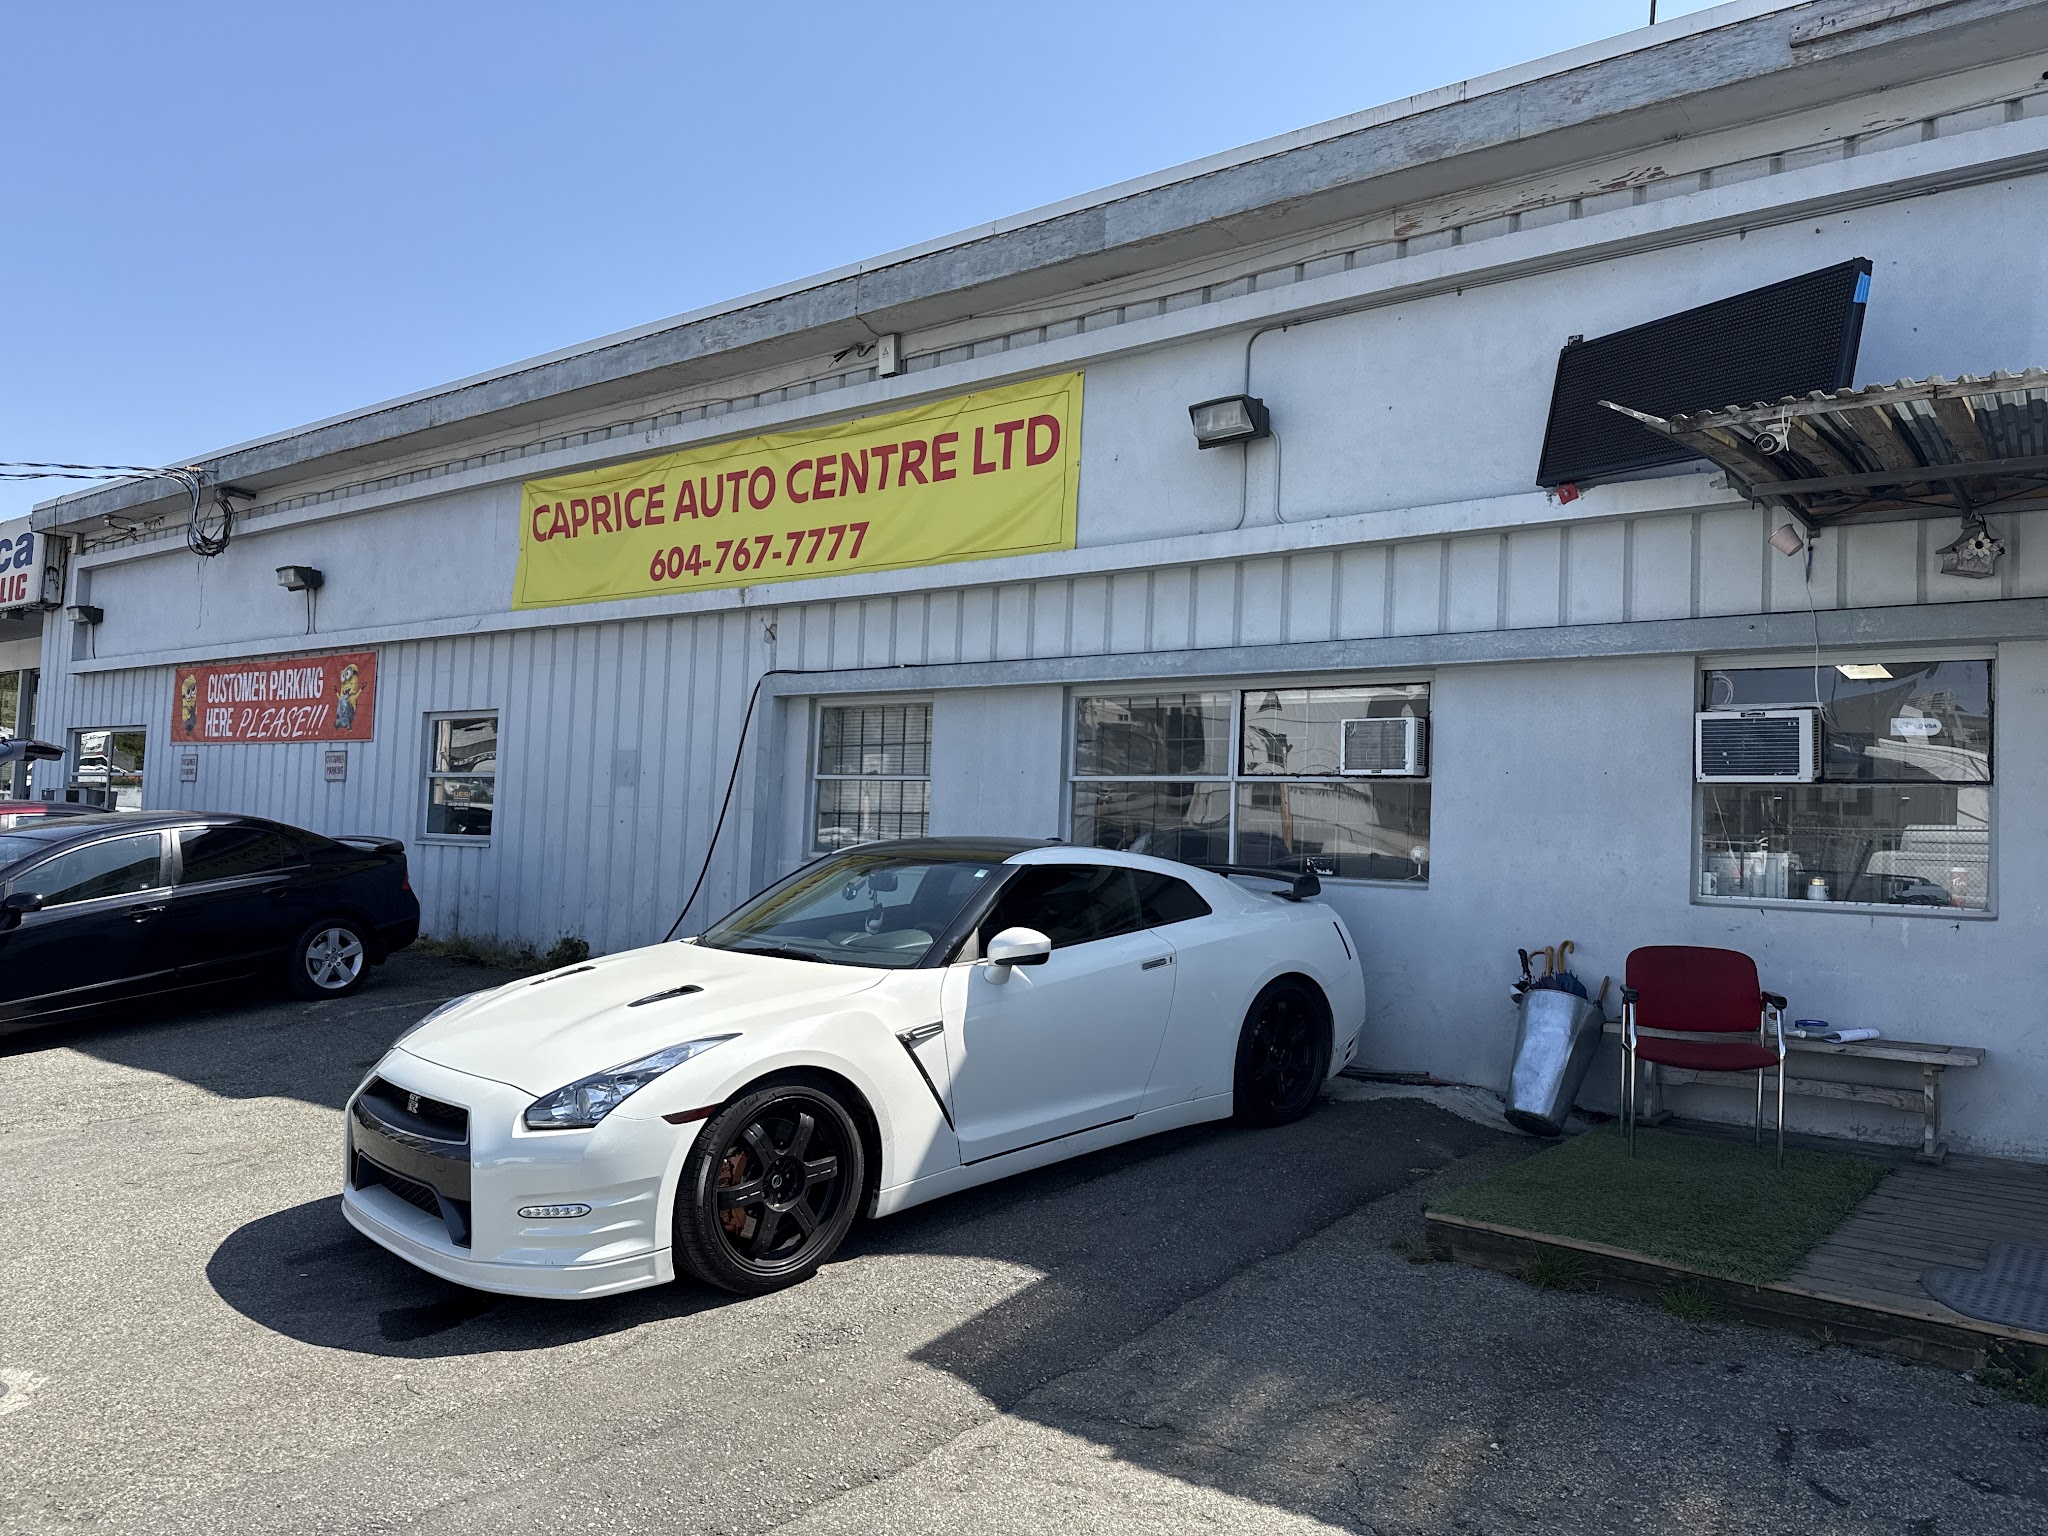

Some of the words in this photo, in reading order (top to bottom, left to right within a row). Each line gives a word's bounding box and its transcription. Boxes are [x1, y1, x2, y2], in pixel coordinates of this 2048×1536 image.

[532, 484, 665, 542] CAPRICE
[673, 465, 776, 522] AUTO
[786, 431, 959, 504] CENTRE
[973, 414, 1060, 475] LTD
[650, 521, 870, 581] 604-767-7777
[207, 671, 266, 703] CUSTOMER
[270, 666, 323, 700] PARKING
[205, 707, 234, 737] HERE
[237, 704, 329, 738] PLEASE!!!
